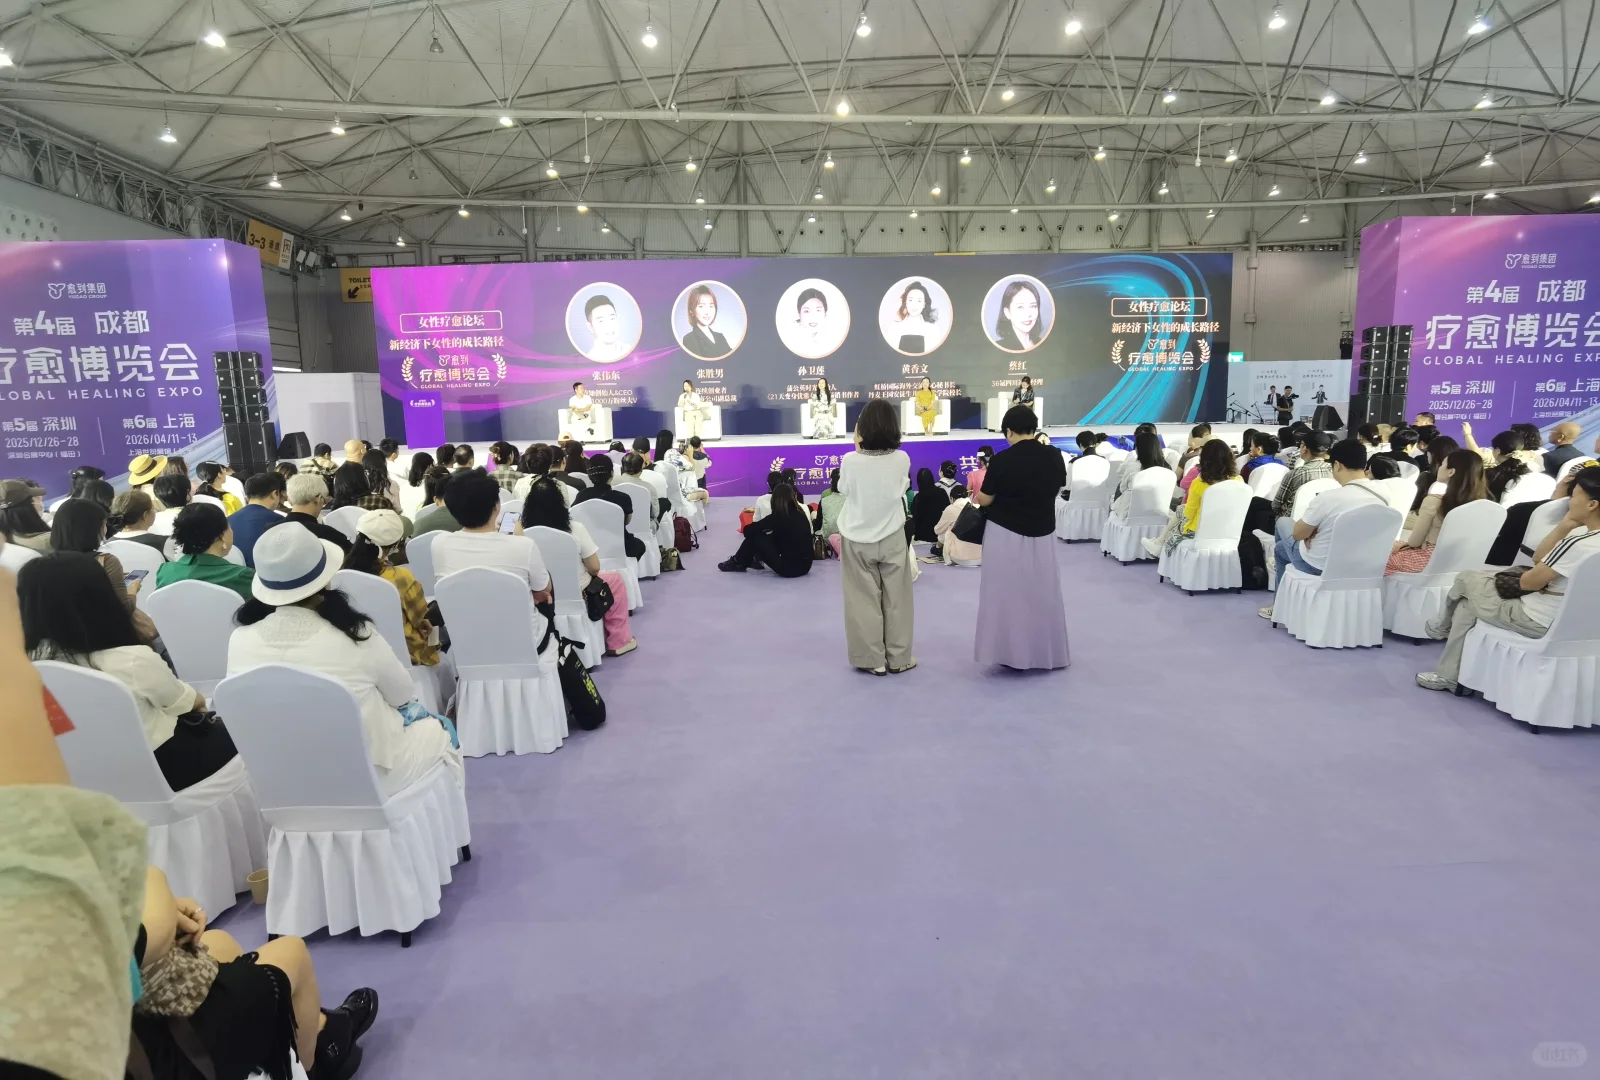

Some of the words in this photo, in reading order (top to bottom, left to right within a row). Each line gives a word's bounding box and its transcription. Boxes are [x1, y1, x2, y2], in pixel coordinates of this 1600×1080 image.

[248, 233, 266, 250] 3-3
[1522, 253, 1556, 264] 愈到集团
[67, 282, 106, 294] 愈到集团
[1466, 280, 1520, 303] 第4届
[1536, 279, 1586, 302] 成都
[1128, 300, 1191, 313] 女性疗愈论坛
[13, 311, 76, 336] 第4届
[94, 310, 150, 334] 成都
[418, 314, 485, 329] 女性疗愈论坛
[1111, 322, 1220, 333] 新经济下女性的成长路径
[389, 336, 504, 351] 新经济下女性的成长路径
[1128, 351, 1194, 365] 疗愈博览会
[1423, 355, 1483, 365] GLOBAL
[1495, 354, 1564, 364] HEALING
[1574, 353, 1600, 363] EXP
[419, 367, 490, 382] 疗愈博览会
[592, 370, 620, 381] 张伟东
[696, 369, 724, 379] 张胜男
[902, 364, 928, 374] 黄香文
[1431, 381, 1461, 394] 第5届
[1465, 380, 1495, 394] 深圳
[1535, 379, 1566, 393] 第6届
[1570, 378, 1600, 392] 上海
[0, 390, 56, 400] LOBAL
[68, 388, 146, 399] HEALING
[158, 386, 203, 397] EXPO
[1429, 399, 1493, 410] 2025/12/26-28
[1533, 397, 1598, 408] 2026/04/11-13
[2, 418, 38, 432] 第5届
[43, 417, 77, 431] 深圳
[123, 415, 157, 430] 第6届
[163, 413, 196, 429] 上海
[5, 436, 79, 448] 2025/12/26-28
[126, 433, 198, 445] 2026/04/11-13
